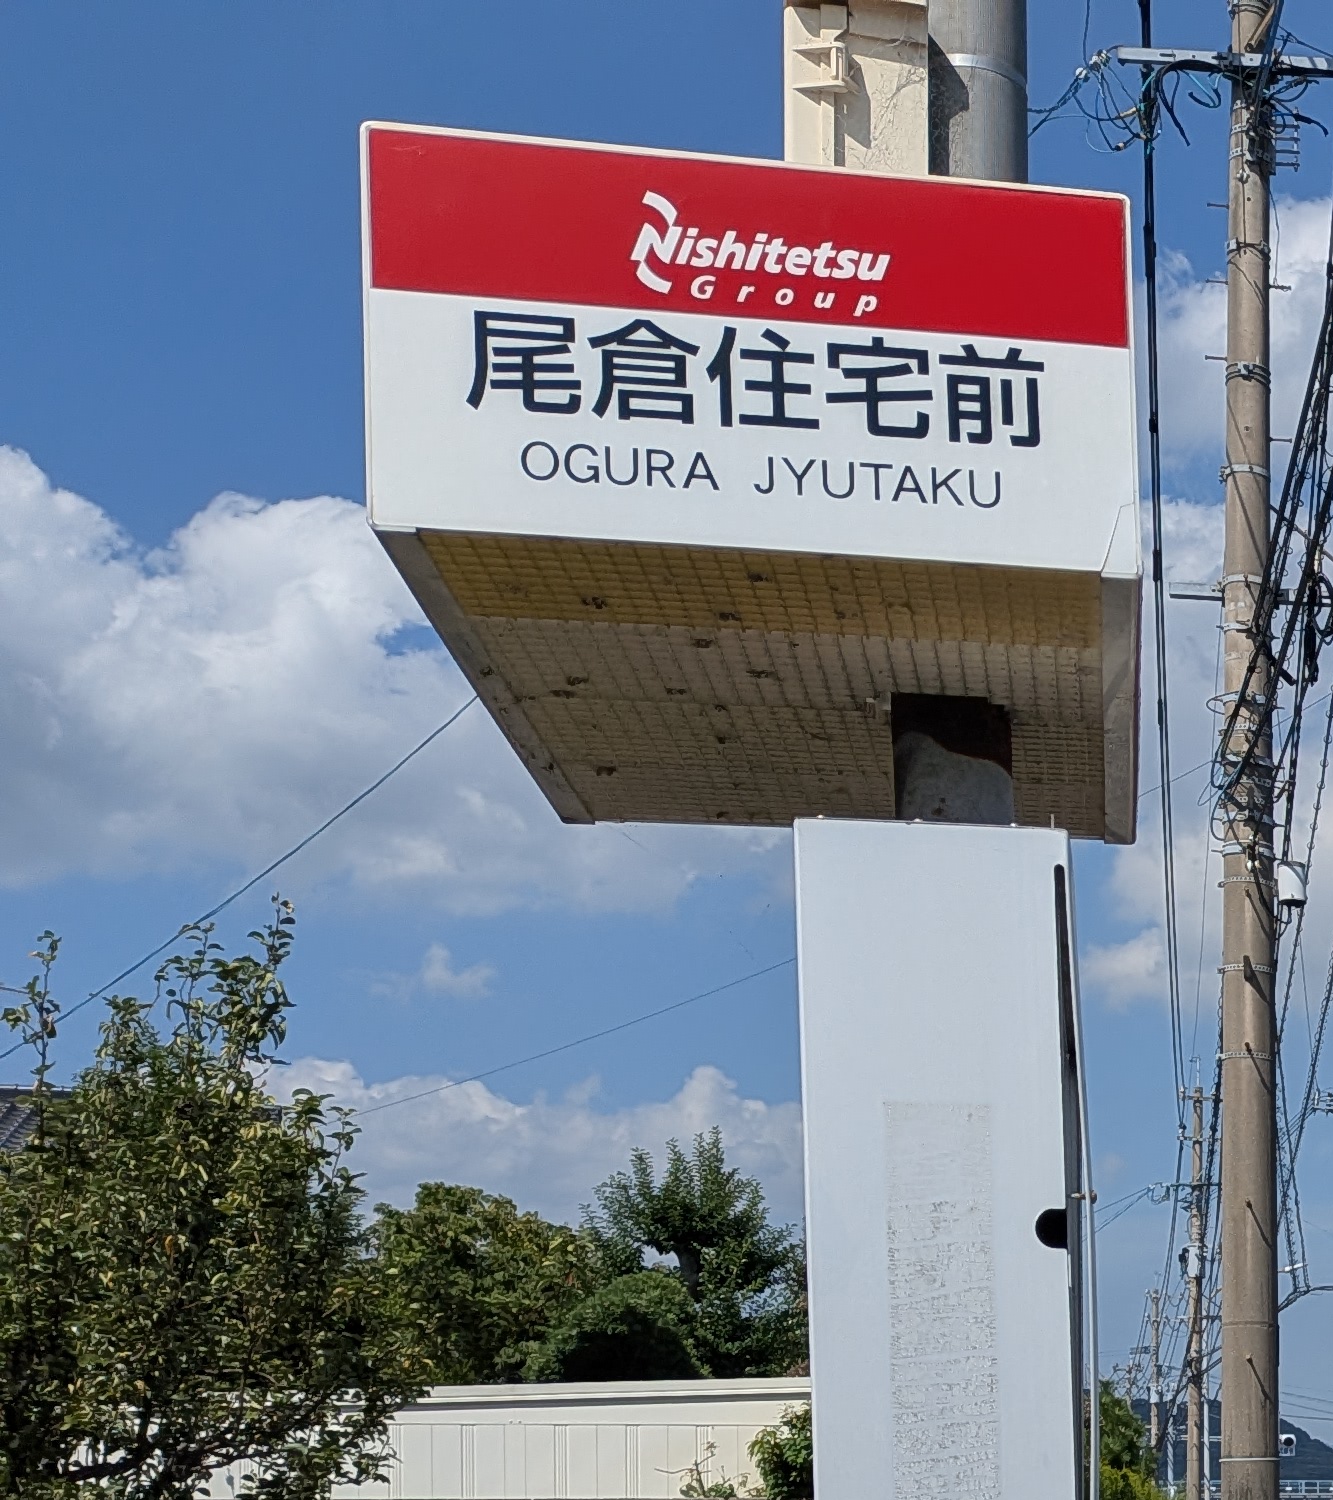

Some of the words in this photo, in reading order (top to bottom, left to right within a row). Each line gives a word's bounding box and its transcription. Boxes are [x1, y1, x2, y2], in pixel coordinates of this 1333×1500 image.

[630, 190, 891, 294] Nishitetsu
[690, 275, 878, 317] Group
[466, 309, 1045, 448] 尾倉住宅前
[520, 440, 720, 491] OGURA
[753, 455, 1002, 509] JYUTAKU
